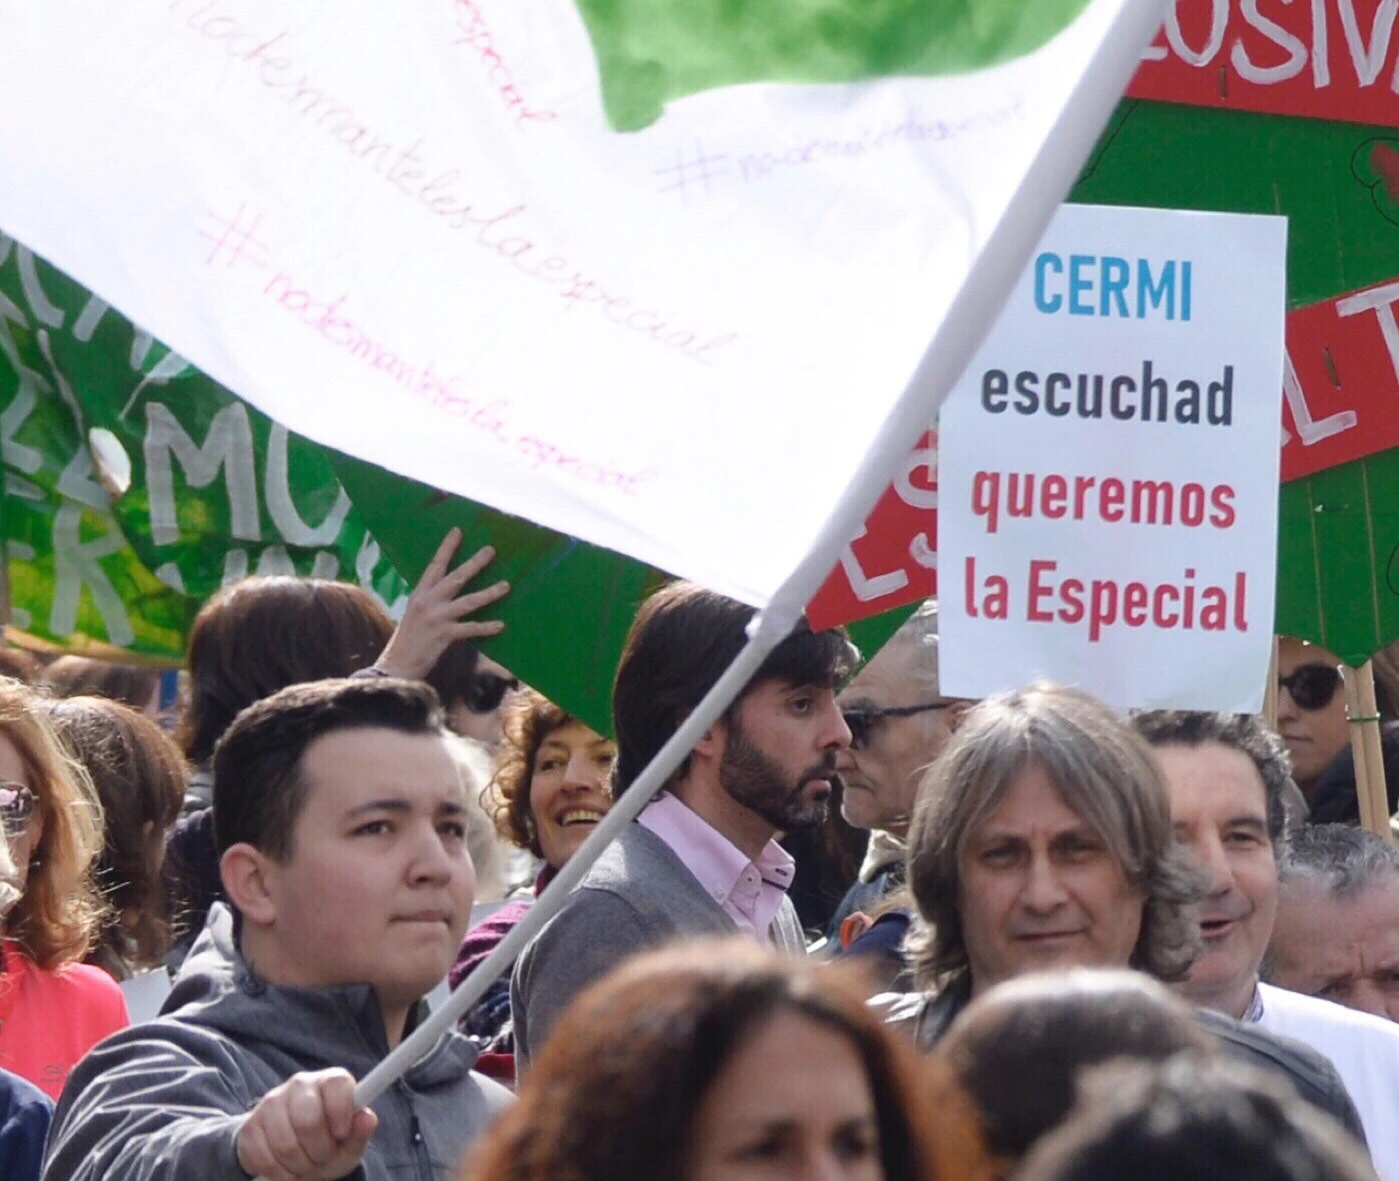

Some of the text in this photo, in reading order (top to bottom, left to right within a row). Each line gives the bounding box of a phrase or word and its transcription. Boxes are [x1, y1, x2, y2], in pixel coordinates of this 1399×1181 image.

[1034, 251, 1191, 320] CERMI
[980, 360, 1234, 426] escuchad
[971, 470, 1236, 534] queremos
[964, 556, 1248, 642] la Especial
